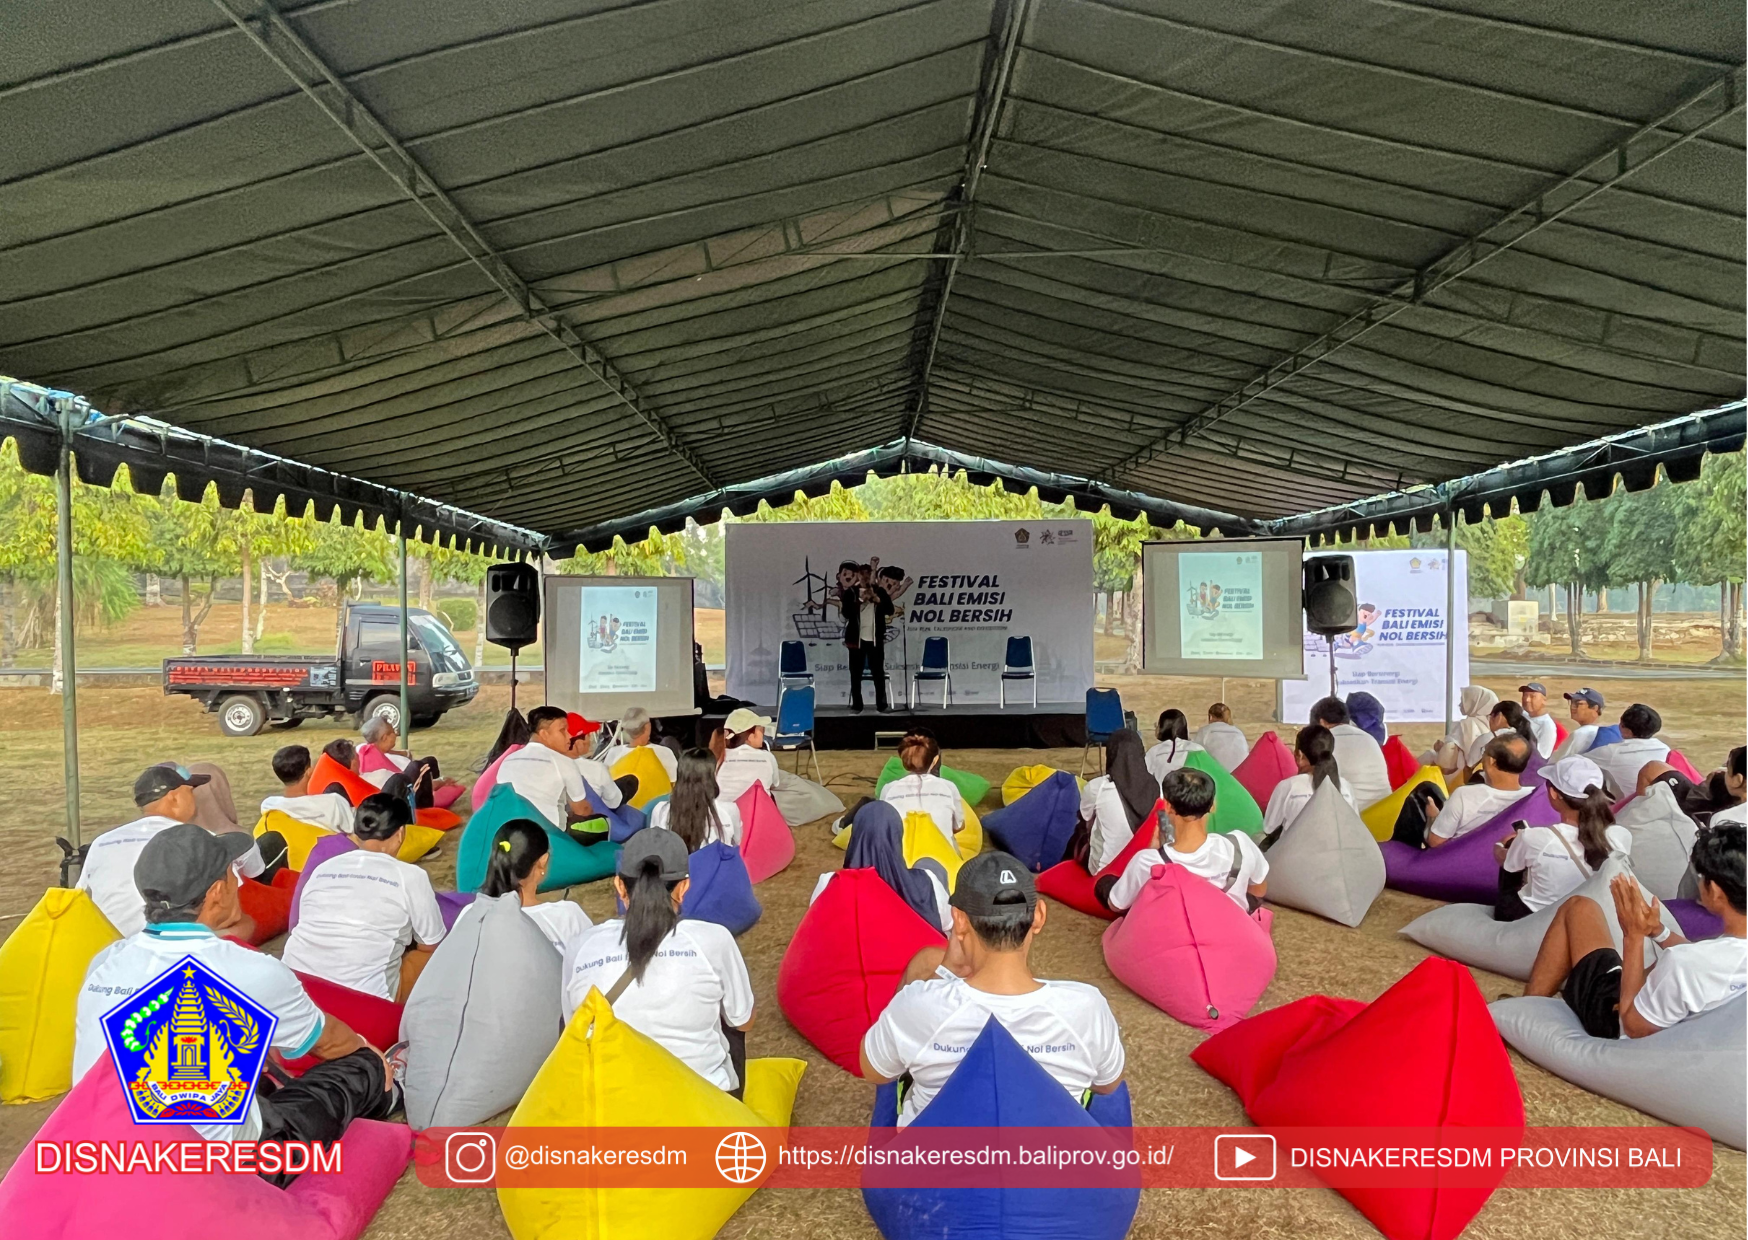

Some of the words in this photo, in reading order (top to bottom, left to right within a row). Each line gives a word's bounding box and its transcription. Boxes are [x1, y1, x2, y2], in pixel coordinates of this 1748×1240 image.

[917, 574, 1000, 589] FESTIVAL
[913, 592, 954, 606] BALI
[956, 591, 1006, 606] EMISI
[909, 609, 945, 623] NOL
[949, 609, 1013, 623] BERSIH
[1384, 608, 1440, 618] FESTIVAL
[1381, 620, 1408, 630] BALI
[1410, 619, 1444, 629] EMISI
[1379, 632, 1404, 641] NOL
[971, 660, 1000, 672] Energi
[575, 958, 604, 974] Dukung
[605, 953, 623, 965] Bali
[669, 949, 698, 958] Bersih
[1045, 1041, 1076, 1054] Bersih
